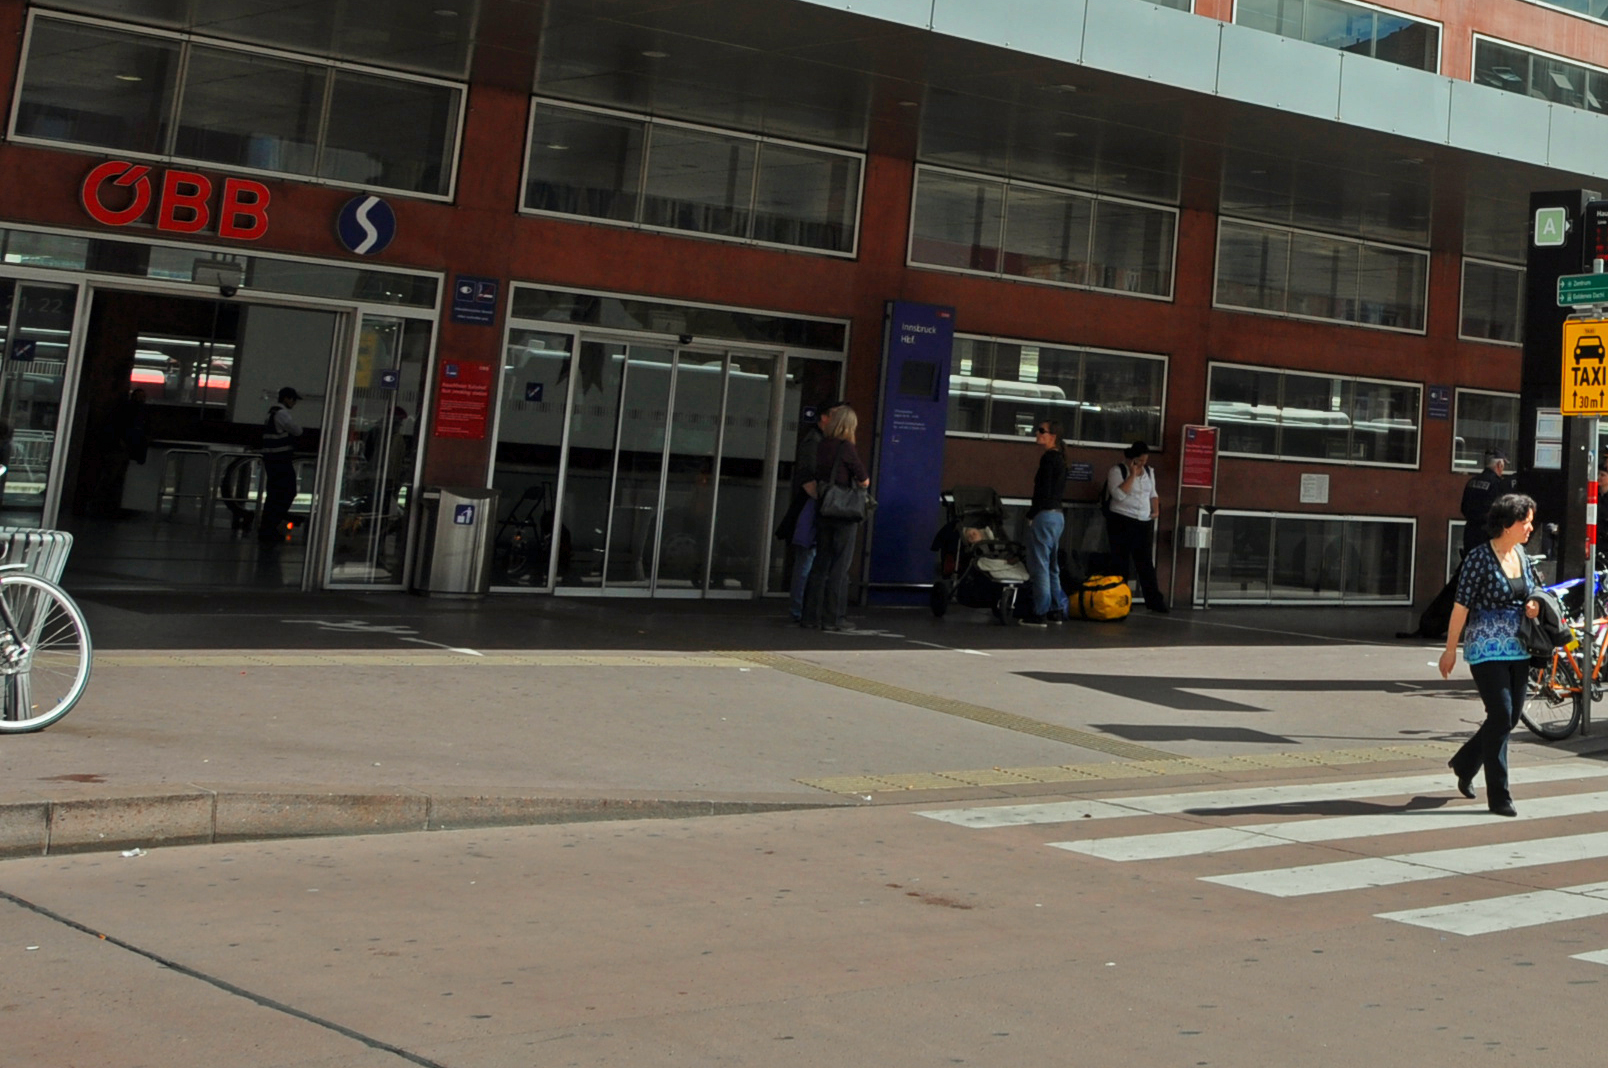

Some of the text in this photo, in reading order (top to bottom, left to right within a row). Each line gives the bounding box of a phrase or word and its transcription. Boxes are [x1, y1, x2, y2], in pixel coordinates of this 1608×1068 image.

[82, 161, 271, 240] ÖBB
[1543, 217, 1556, 235] A
[901, 322, 936, 335] Innsbruck
[1571, 366, 1606, 386] TAXI
